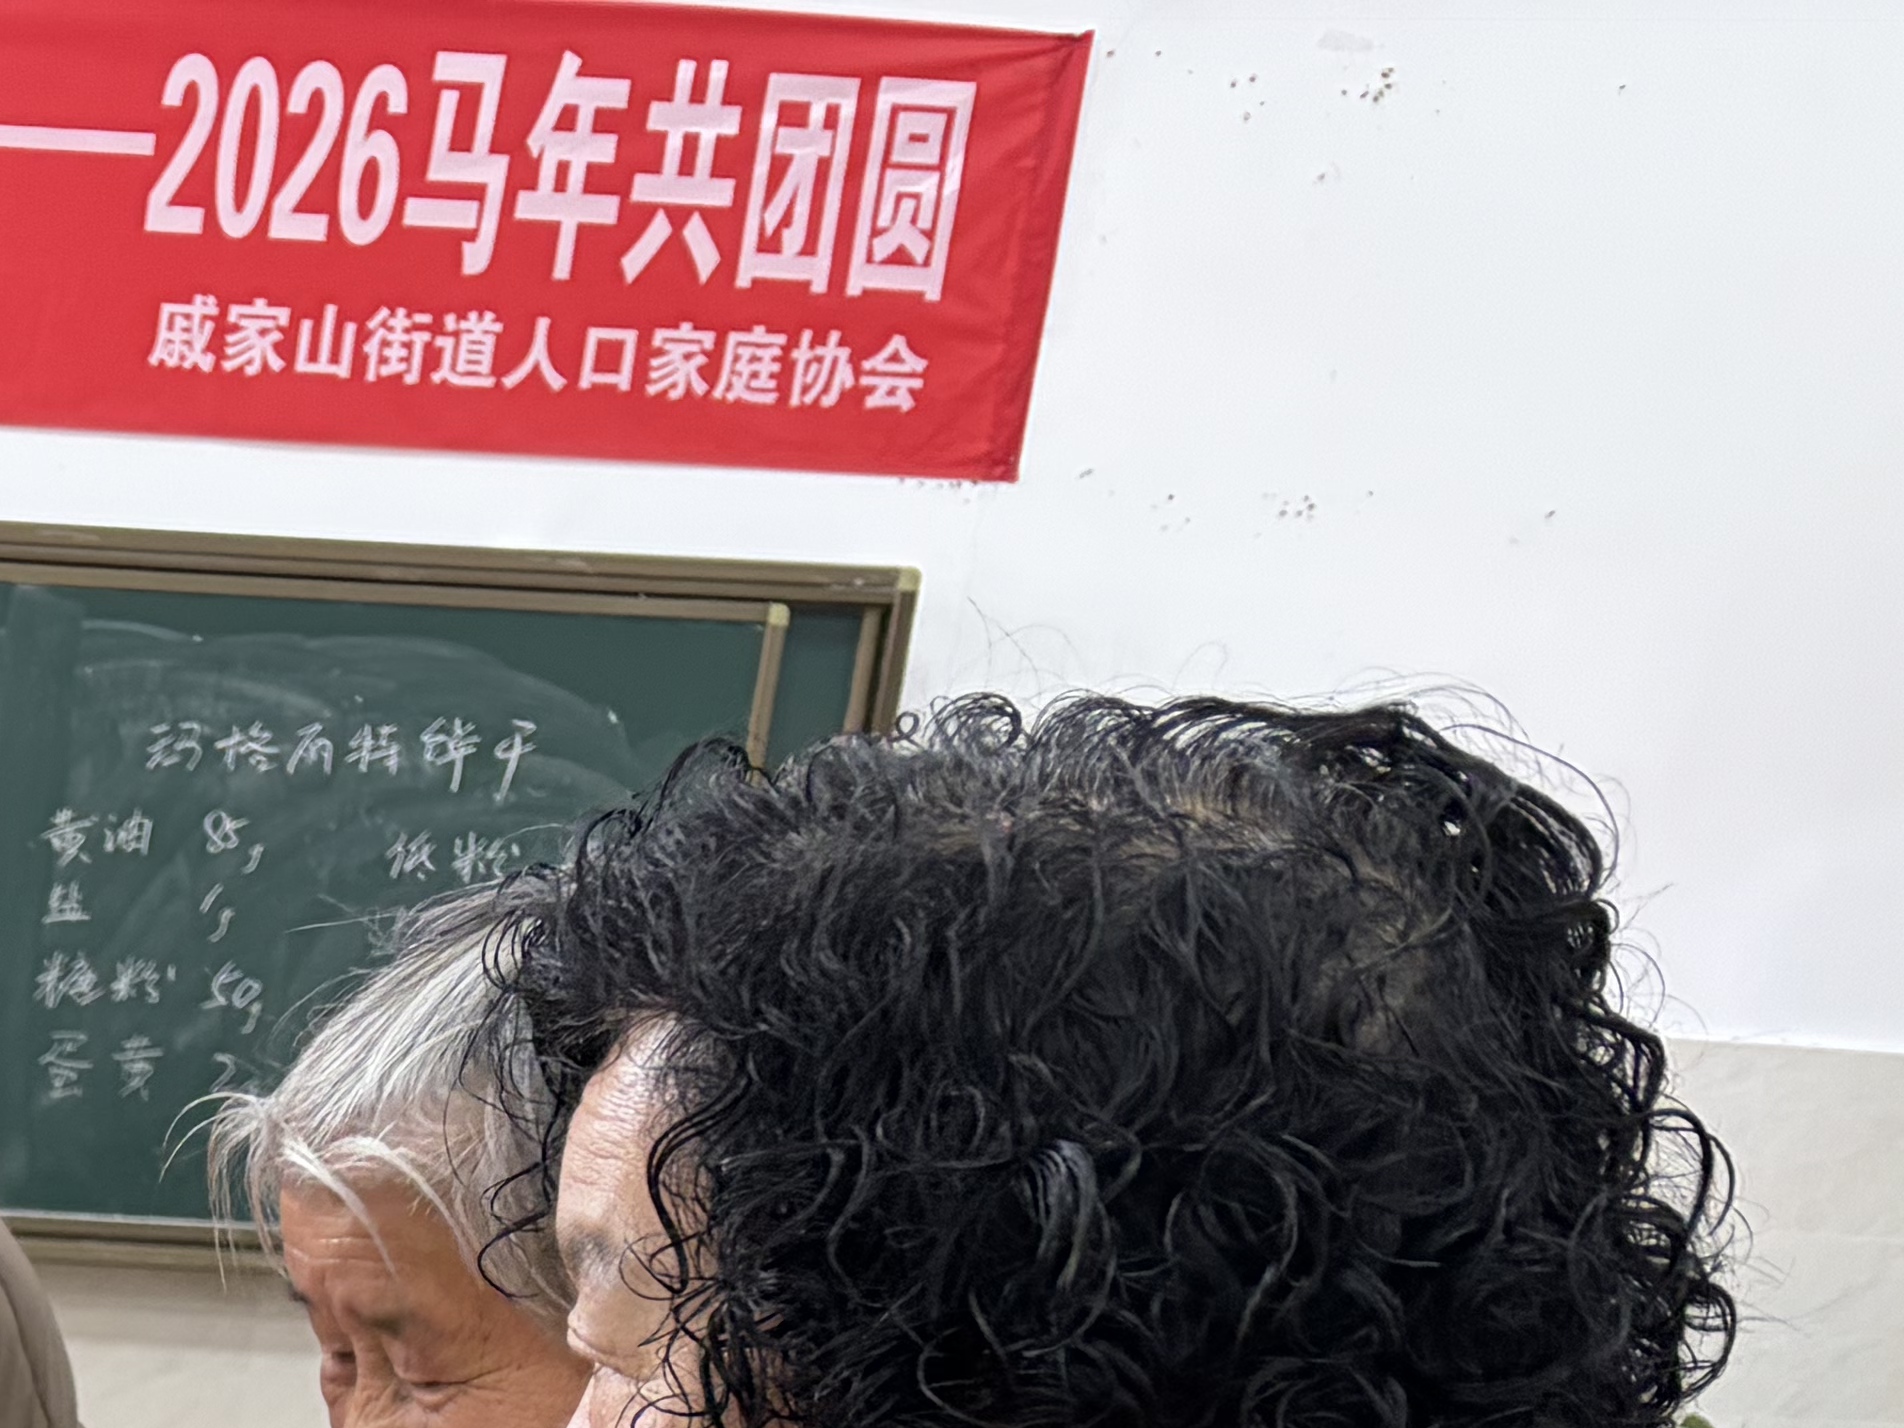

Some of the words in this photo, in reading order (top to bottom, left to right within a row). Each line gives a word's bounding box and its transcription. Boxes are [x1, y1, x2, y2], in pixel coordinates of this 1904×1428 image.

[147, 292, 930, 412] 戚家山街道人口家庭协会
[41, 807, 154, 868] 黄油
[38, 1029, 164, 1101] 蛋黄
